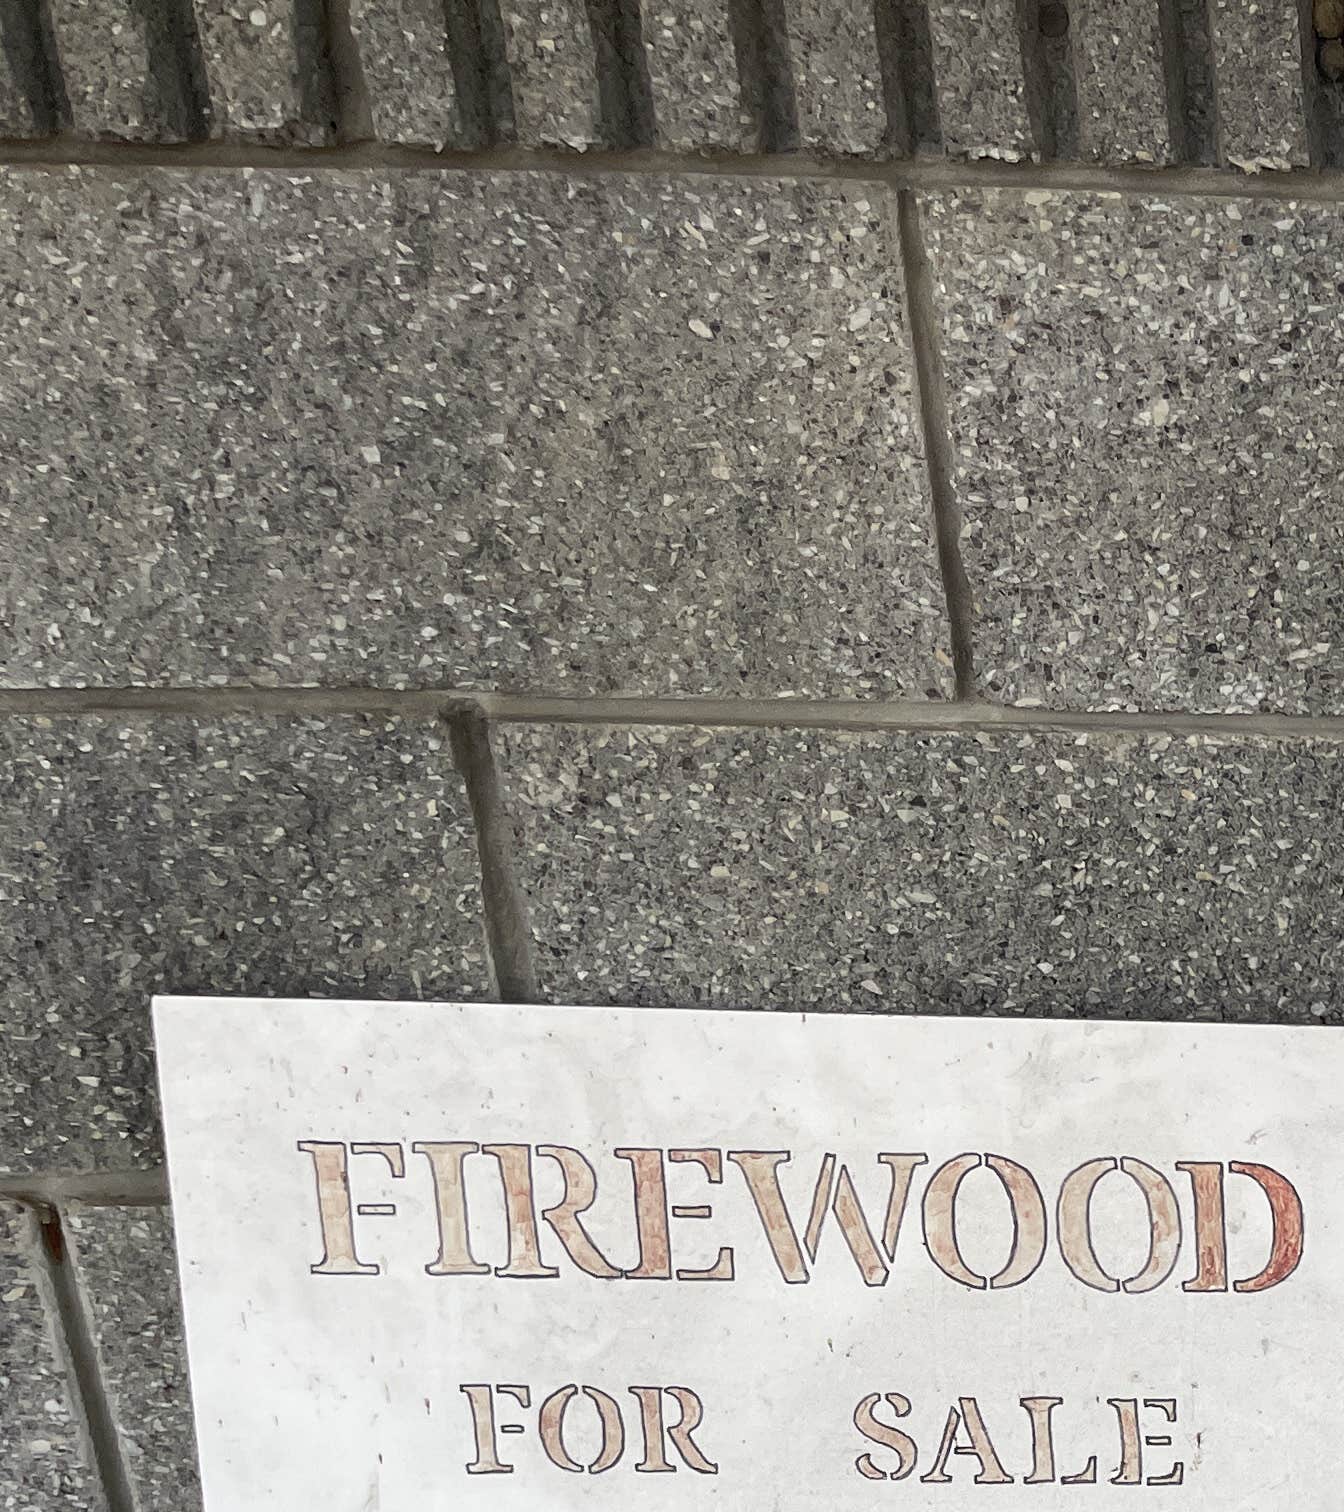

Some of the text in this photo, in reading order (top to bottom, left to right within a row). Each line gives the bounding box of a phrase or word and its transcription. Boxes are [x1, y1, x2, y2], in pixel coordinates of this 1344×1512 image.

[297, 1141, 1304, 1293] FIREWOOD
[460, 1384, 1183, 1486] FOR SALE
